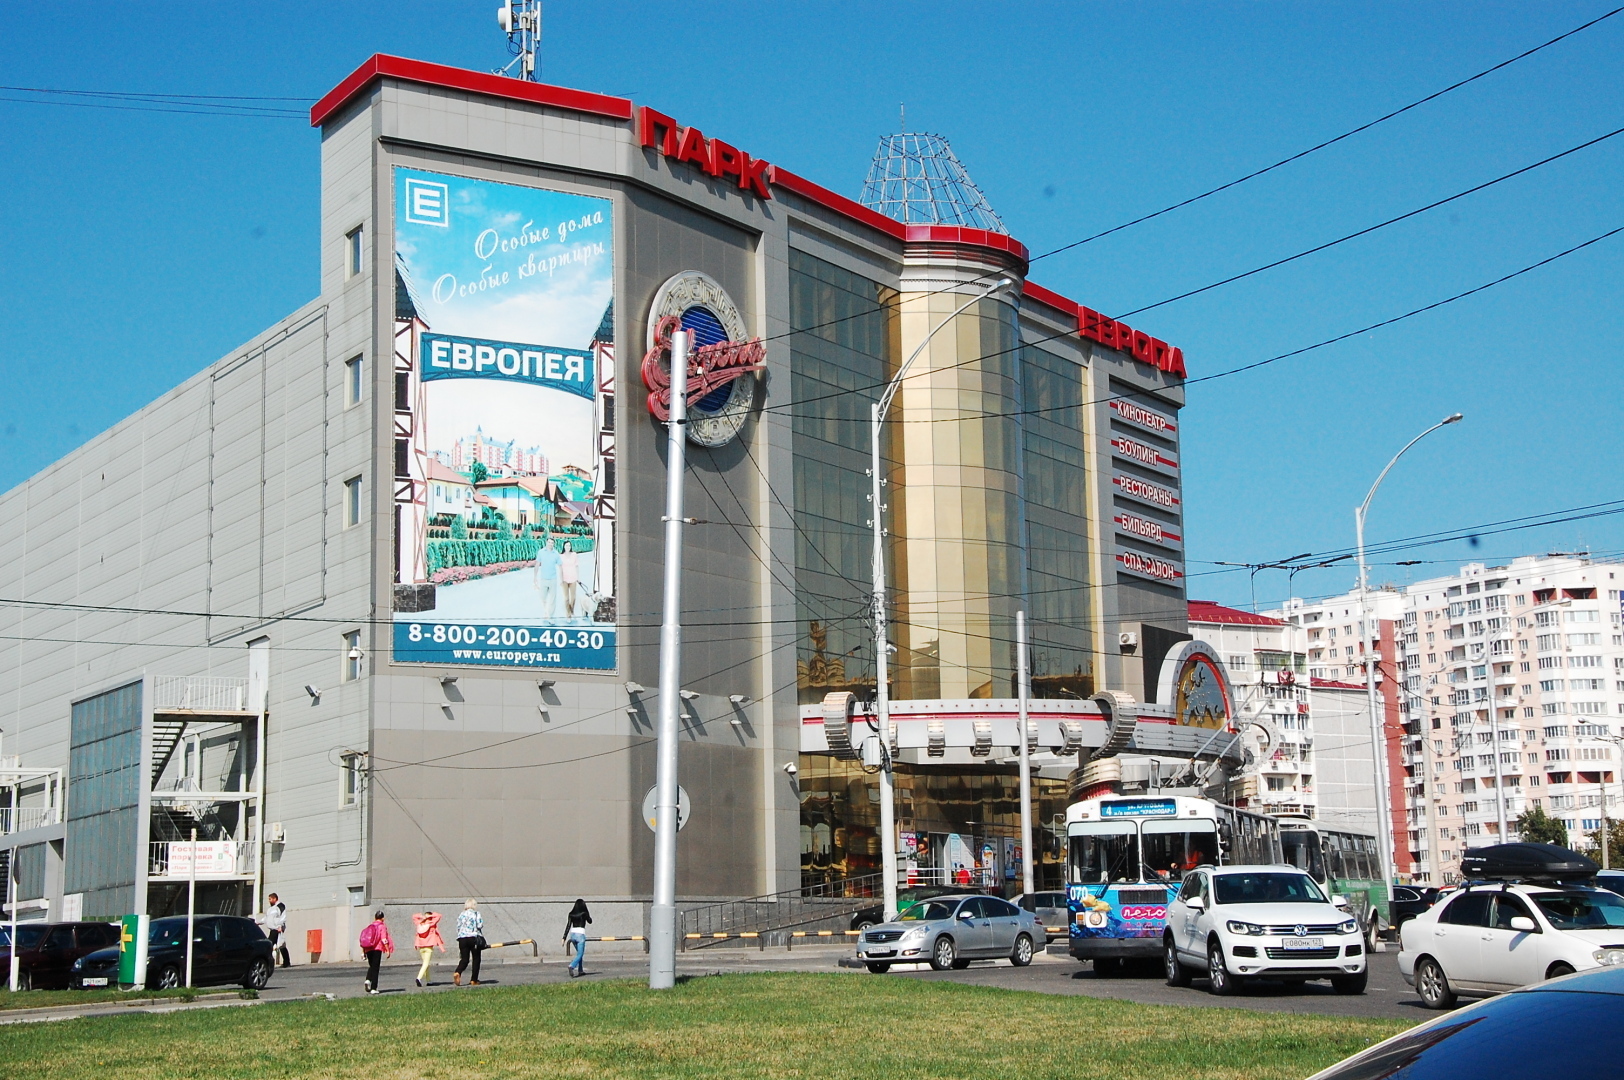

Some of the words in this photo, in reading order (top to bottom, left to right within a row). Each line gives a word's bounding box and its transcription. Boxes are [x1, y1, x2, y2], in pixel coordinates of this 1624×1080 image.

[640, 106, 772, 200] ПАРК
[475, 219, 550, 260] Особые
[558, 210, 603, 243] дома
[432, 264, 510, 304] Особые
[518, 241, 604, 278] квартиры
[1079, 305, 1188, 379] ЕВРОПА
[431, 340, 584, 382] ЕВРОПЕЯ
[1117, 401, 1166, 432] КИНОТЕАТР
[1118, 439, 1160, 466] БОУЛИНГ
[1119, 476, 1173, 507] РЕСТОРАНЫ
[1121, 514, 1163, 542] БИЛЬЯРД
[1123, 552, 1175, 580] СПА-САЛОН
[409, 624, 604, 649] 8-800-200-40-30
[453, 649, 560, 663] www.europeya.ru
[1070, 887, 1088, 900] 070
